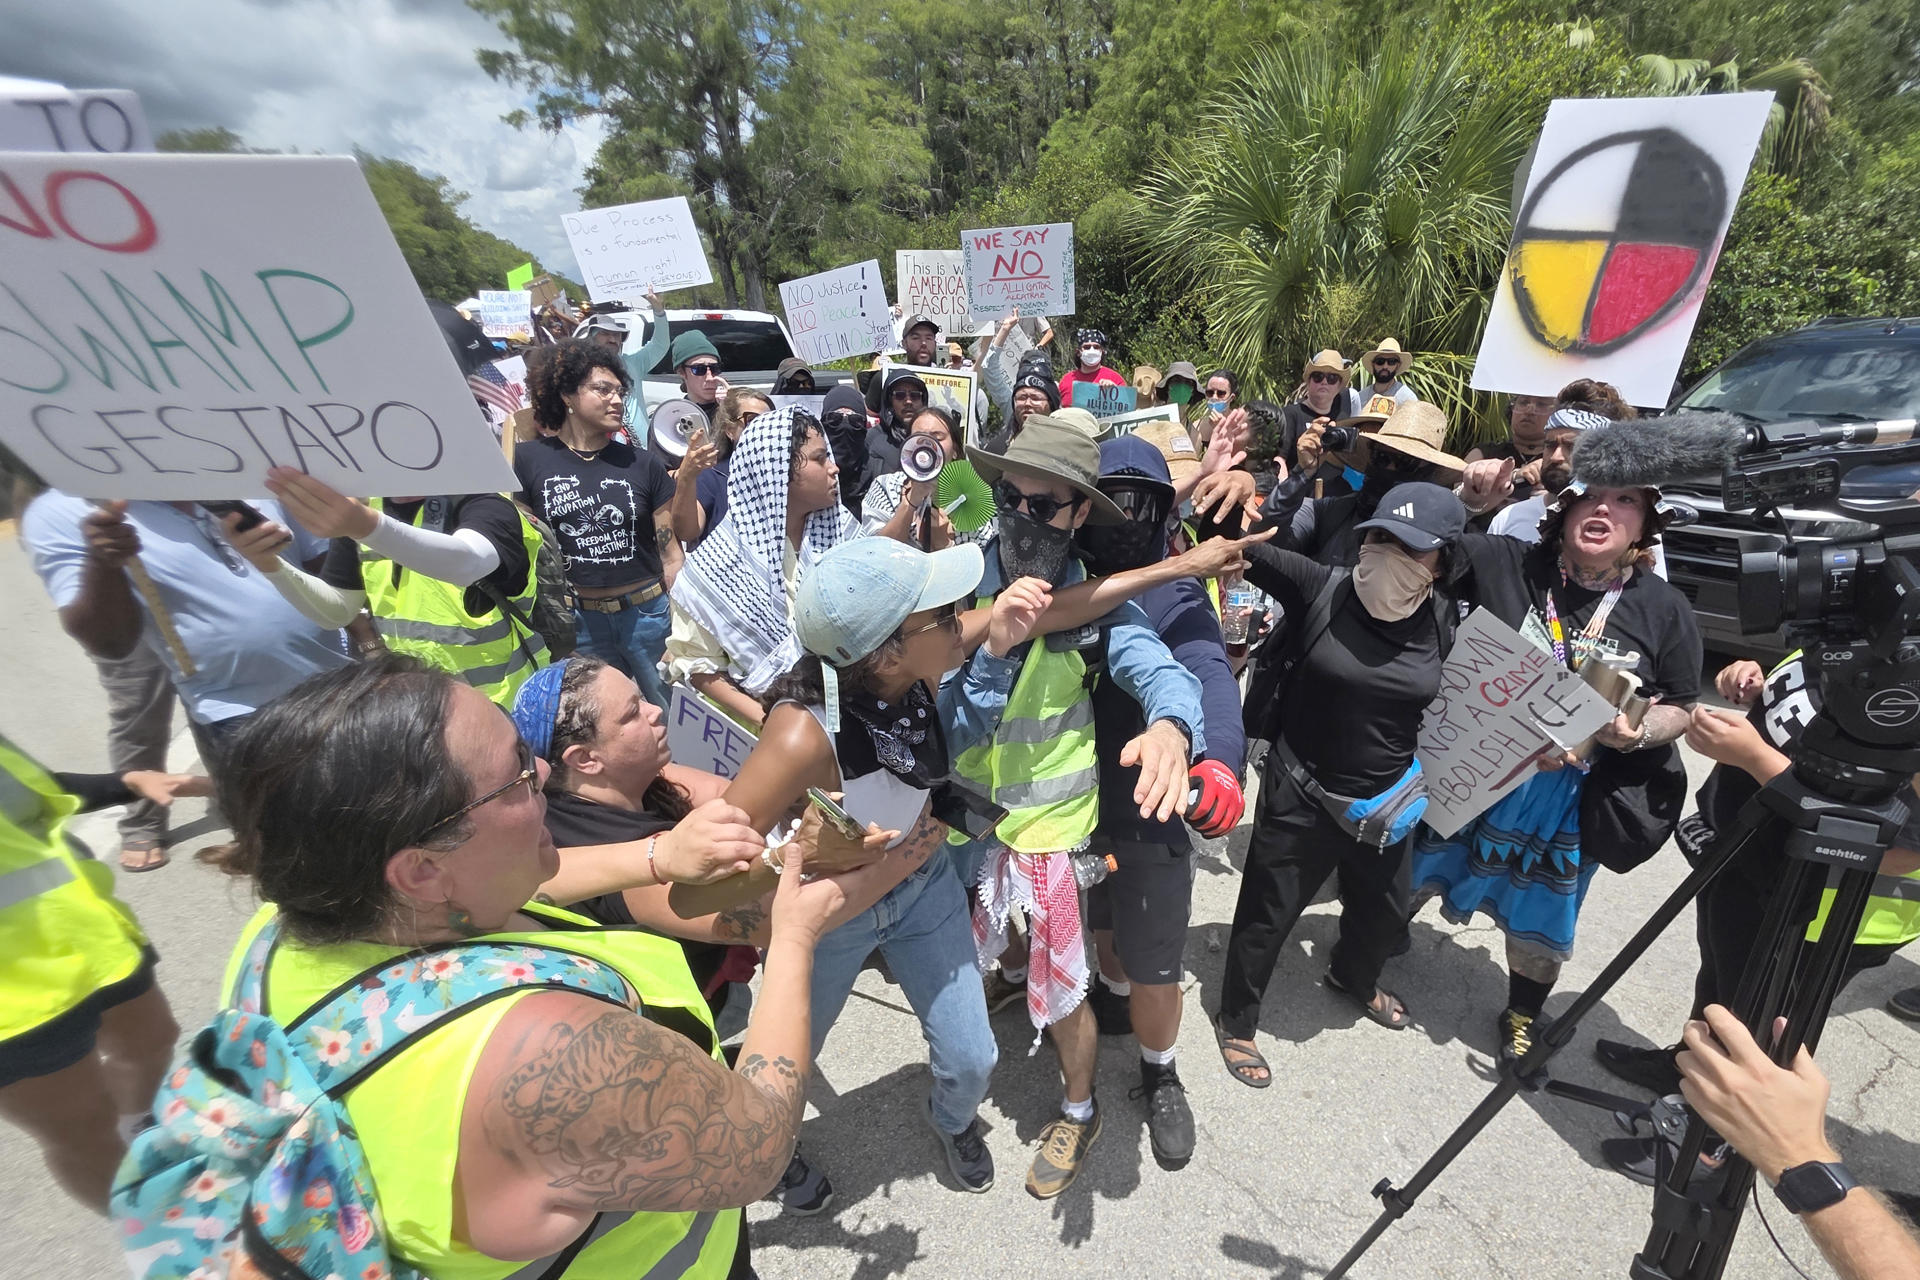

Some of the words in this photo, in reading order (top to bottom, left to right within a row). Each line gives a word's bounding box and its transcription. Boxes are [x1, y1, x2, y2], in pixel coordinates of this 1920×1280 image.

[14, 96, 134, 153] TO
[566, 216, 600, 236] Due
[606, 210, 675, 230] Process
[974, 232, 1004, 251] WE
[1010, 227, 1050, 247] SAY
[904, 255, 931, 275] This
[937, 263, 946, 276] is
[992, 249, 1044, 277] NO
[590, 267, 638, 286] human
[909, 276, 967, 295] AMERICA
[788, 284, 814, 310] NO
[978, 282, 994, 297] TO
[1001, 281, 1054, 295] ALLIGATOR
[912, 295, 970, 315] FASCIS
[973, 303, 1006, 313] RESPECT
[792, 309, 817, 332] NO
[949, 315, 976, 334] Like
[813, 333, 836, 360] ICE
[835, 330, 850, 356] IN
[1098, 385, 1120, 402] NO
[1086, 398, 1129, 412] ALLIGATOR
[31, 400, 444, 475] GESTAPO
[552, 490, 580, 506] ISRAELI
[553, 482, 571, 494] END
[575, 534, 611, 549] FREEDOM
[612, 528, 628, 541] FOR
[589, 538, 629, 557] PALESTINE!
[1822, 651, 1853, 660] ace
[1479, 646, 1551, 708] CRIME
[1464, 704, 1496, 727] A
[678, 695, 754, 767] FRE
[1420, 710, 1469, 760] NOT
[1430, 729, 1530, 816] ABOLISH
[1815, 845, 1868, 863] sachtler
